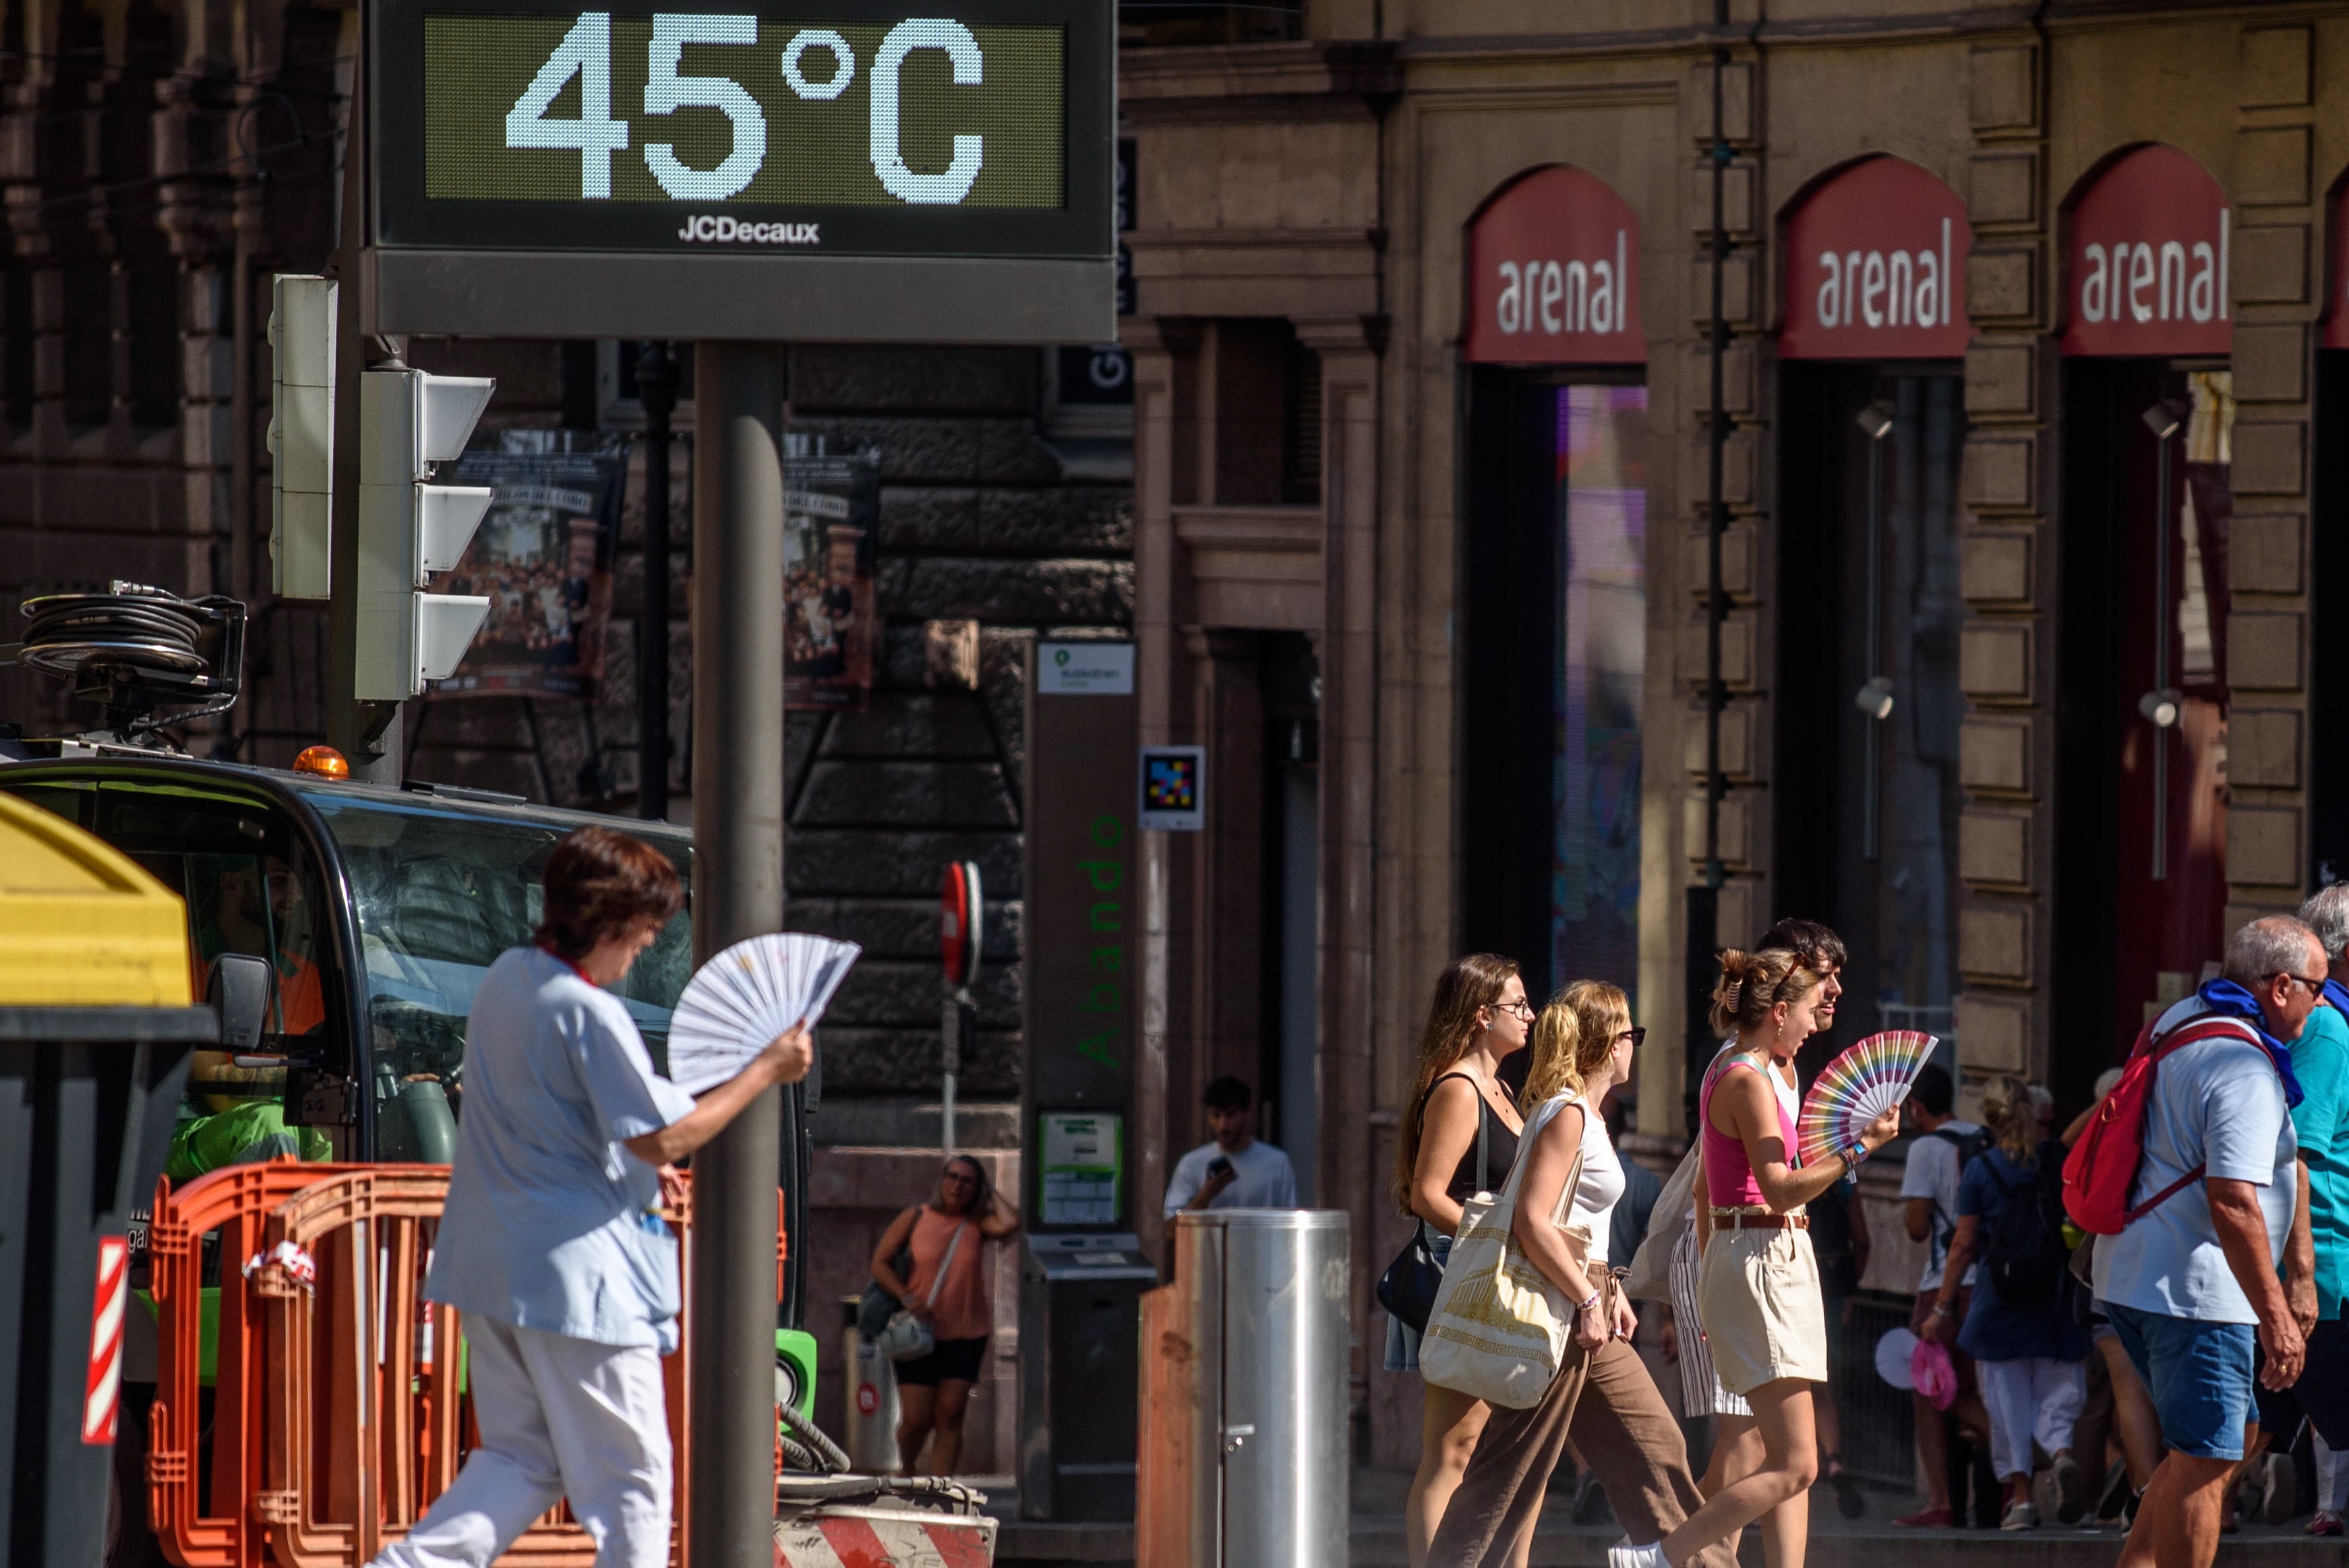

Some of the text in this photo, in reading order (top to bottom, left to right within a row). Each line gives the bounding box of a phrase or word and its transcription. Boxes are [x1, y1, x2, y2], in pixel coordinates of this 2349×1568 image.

[506, 12, 983, 204] 45°C
[678, 215, 820, 243] JCDecaux
[1497, 230, 1626, 334] arenal
[1817, 217, 1951, 328] arenal
[2081, 208, 2230, 325] arenal
[1076, 814, 1122, 1068] Abando
